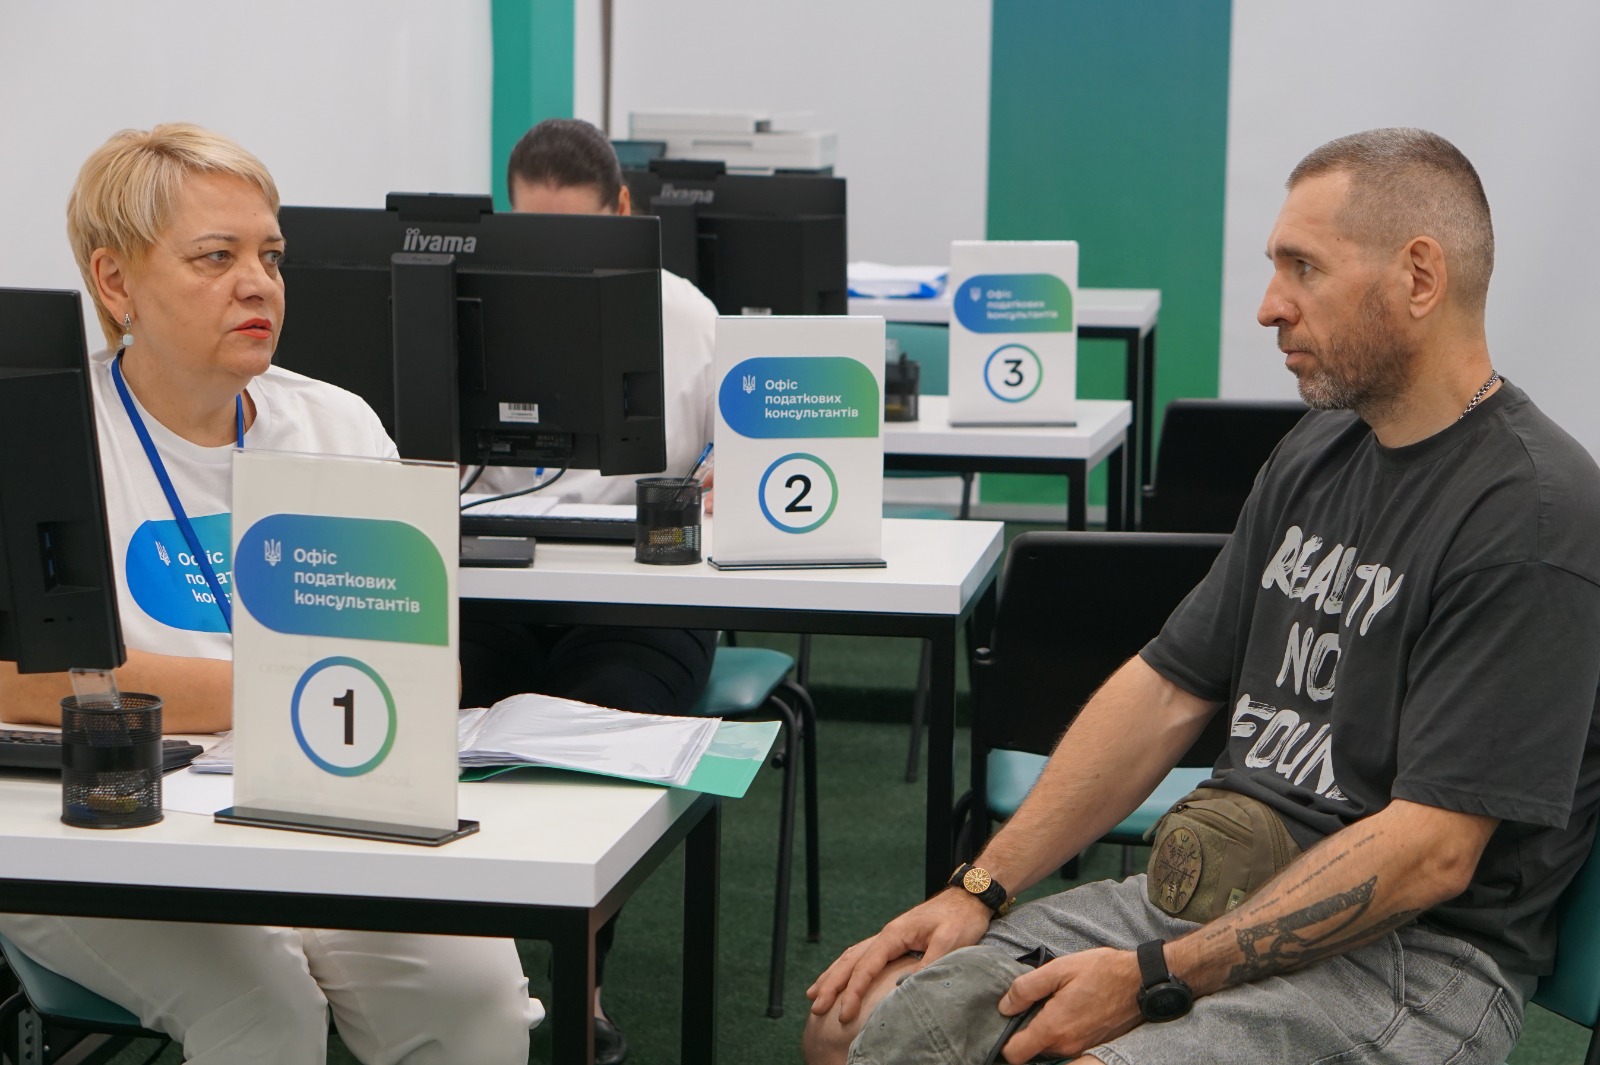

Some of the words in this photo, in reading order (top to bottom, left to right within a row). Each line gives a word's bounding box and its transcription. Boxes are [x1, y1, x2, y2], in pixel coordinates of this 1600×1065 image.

[403, 227, 477, 253] iiyama
[764, 379, 798, 392] Офіс
[1004, 359, 1024, 387] 3
[764, 393, 842, 405] податкових
[764, 407, 859, 420] консультантів
[784, 474, 812, 513] 2
[293, 548, 338, 567] Офіс
[294, 571, 397, 590] податкових
[1261, 525, 1404, 637] REALTY
[294, 589, 420, 613] консультантів
[333, 689, 354, 745] 1
[1230, 693, 1350, 801] FOUN
